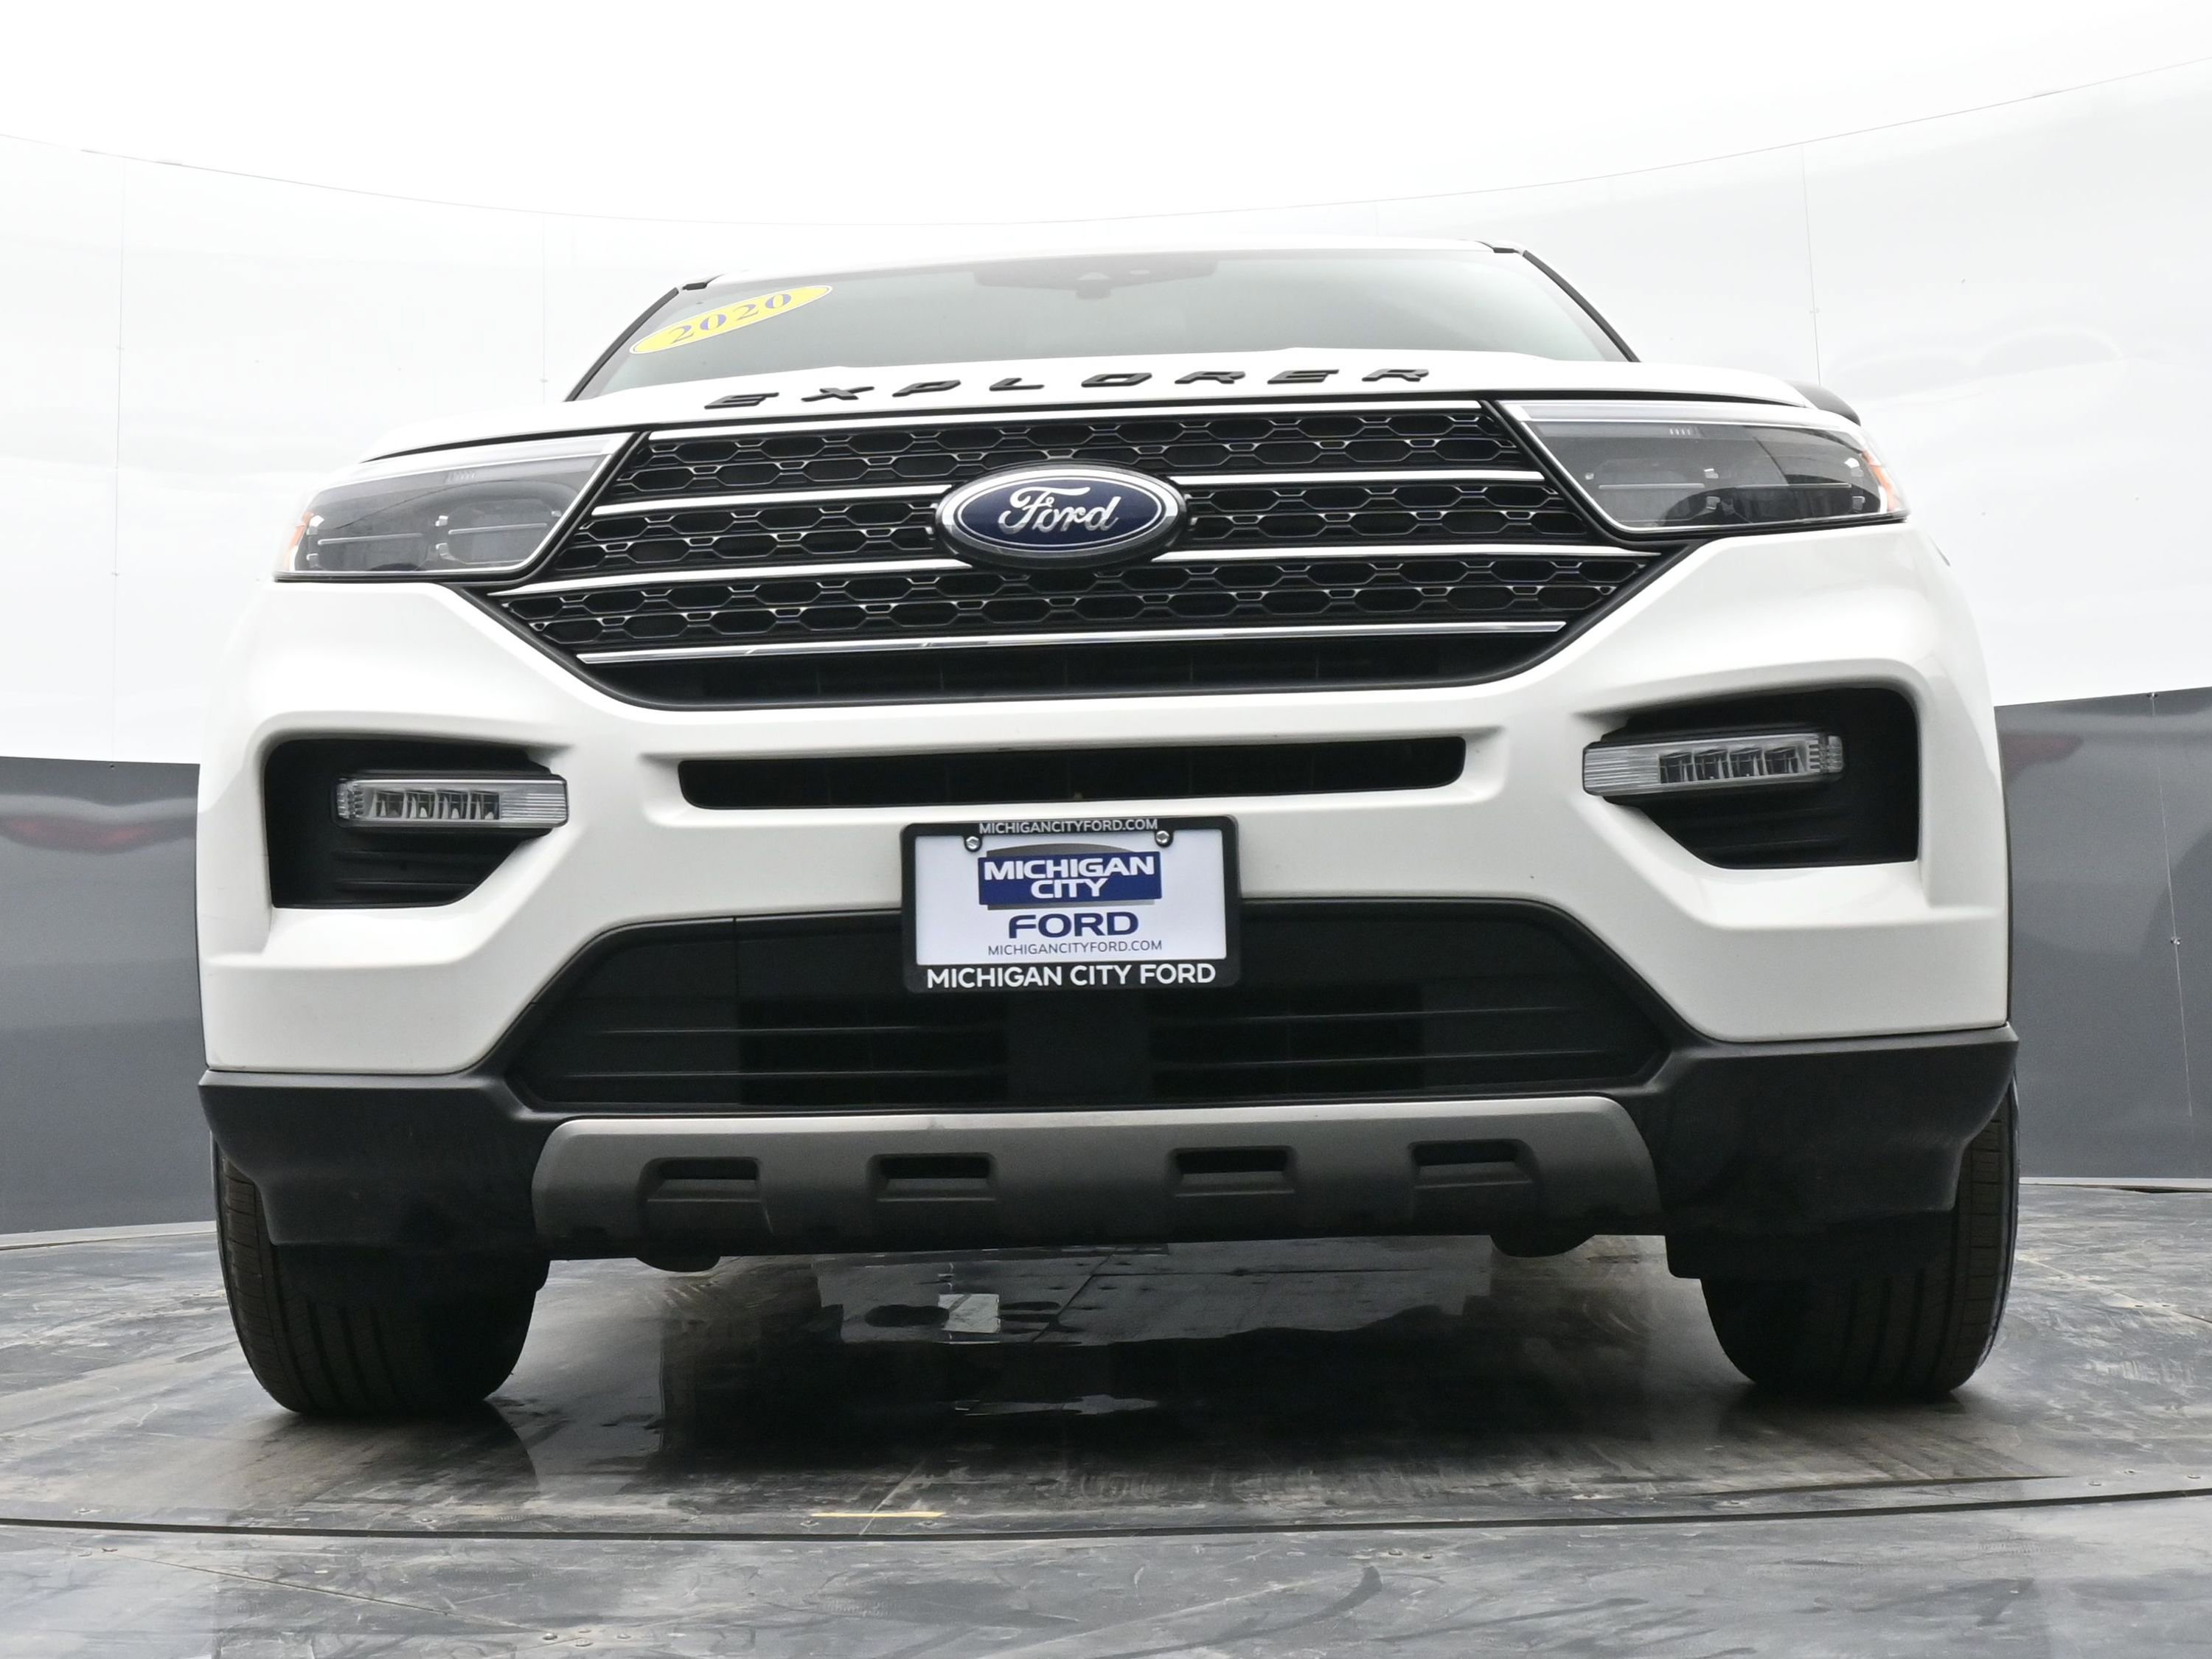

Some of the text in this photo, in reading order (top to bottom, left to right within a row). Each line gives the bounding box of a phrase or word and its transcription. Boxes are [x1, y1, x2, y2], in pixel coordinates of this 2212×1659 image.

[668, 293, 792, 345] 2020
[703, 369, 1430, 410] EXPLORER
[998, 485, 1121, 535] Ford
[978, 818, 1158, 835] MICHIGANCITYFORD.COM
[983, 855, 1155, 881] MICHIGAN
[1030, 878, 1110, 900] CITY
[1008, 911, 1139, 939] FORD
[987, 940, 1163, 956] MICHIGANCITYFORD.COM
[927, 963, 1217, 989] MICHIGAN CITY FORD
